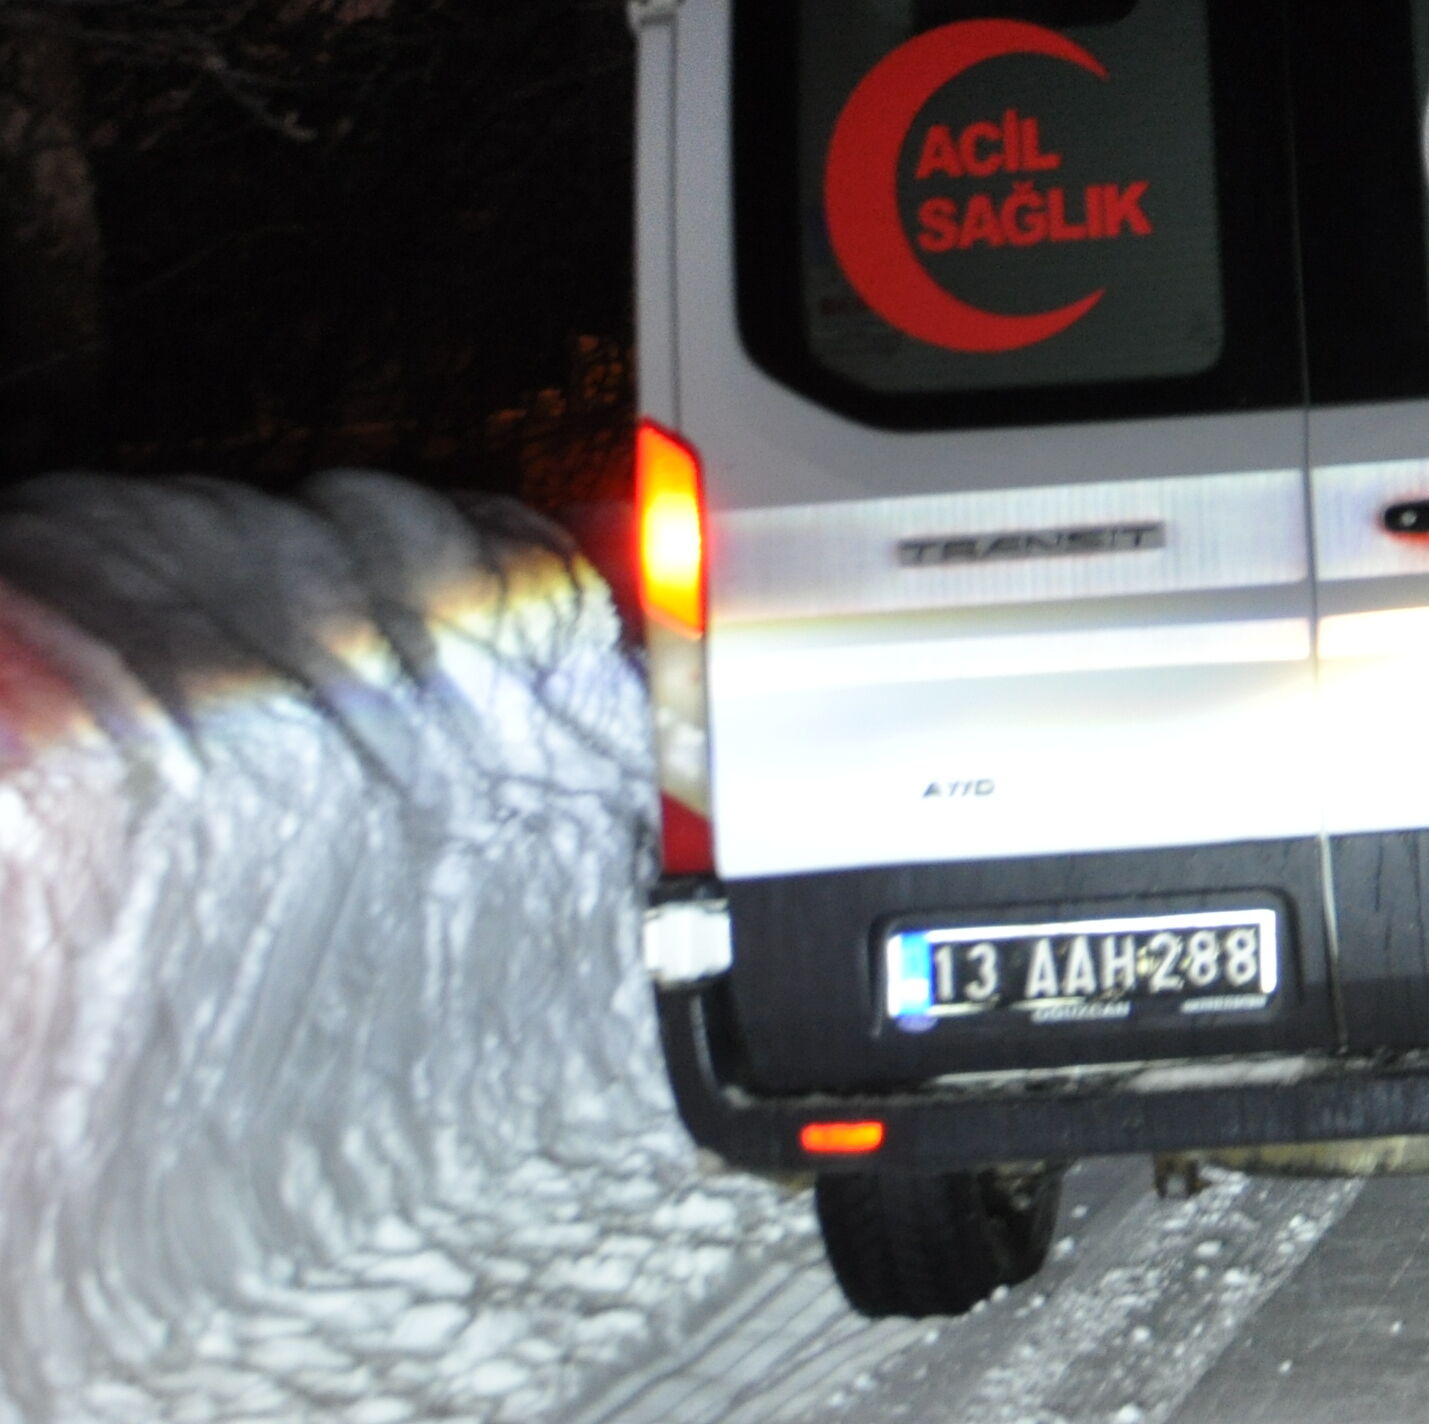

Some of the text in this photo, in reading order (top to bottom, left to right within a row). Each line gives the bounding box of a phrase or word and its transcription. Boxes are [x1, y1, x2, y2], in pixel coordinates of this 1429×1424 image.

[915, 108, 1061, 180] ACİL
[916, 180, 1153, 253] SAĞLIK
[933, 926, 1259, 1002] 13 AAH 288
